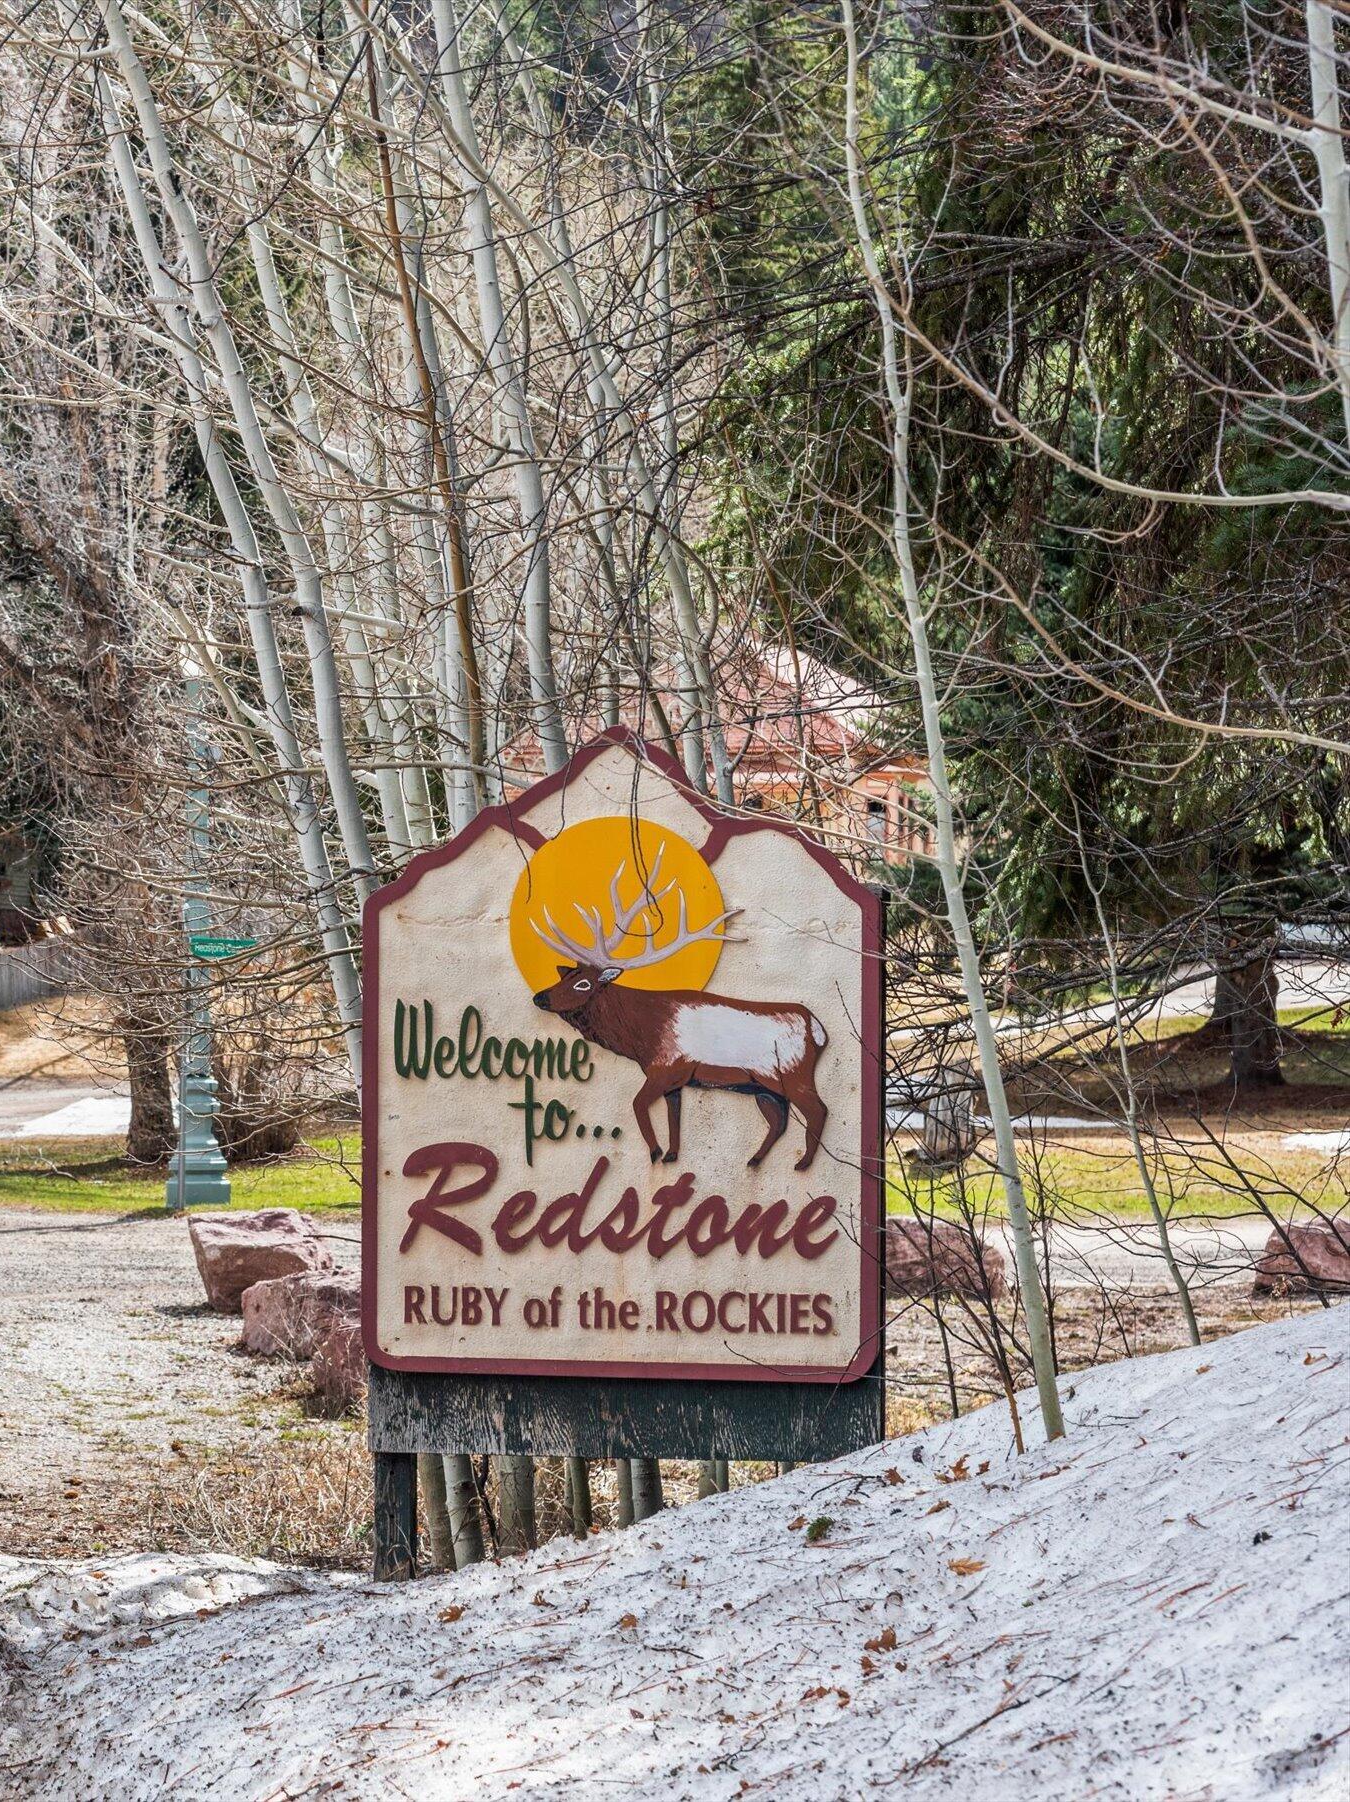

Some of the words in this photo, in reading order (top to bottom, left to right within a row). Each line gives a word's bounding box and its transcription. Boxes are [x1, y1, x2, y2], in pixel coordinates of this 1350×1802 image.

[393, 998, 594, 1082] Welcome
[507, 1073, 623, 1168] to...
[399, 1141, 839, 1260] Redstone
[403, 1285, 510, 1327] RUBY
[523, 1285, 564, 1330] of
[577, 1287, 640, 1331] the
[654, 1290, 834, 1336] ROCKIES
